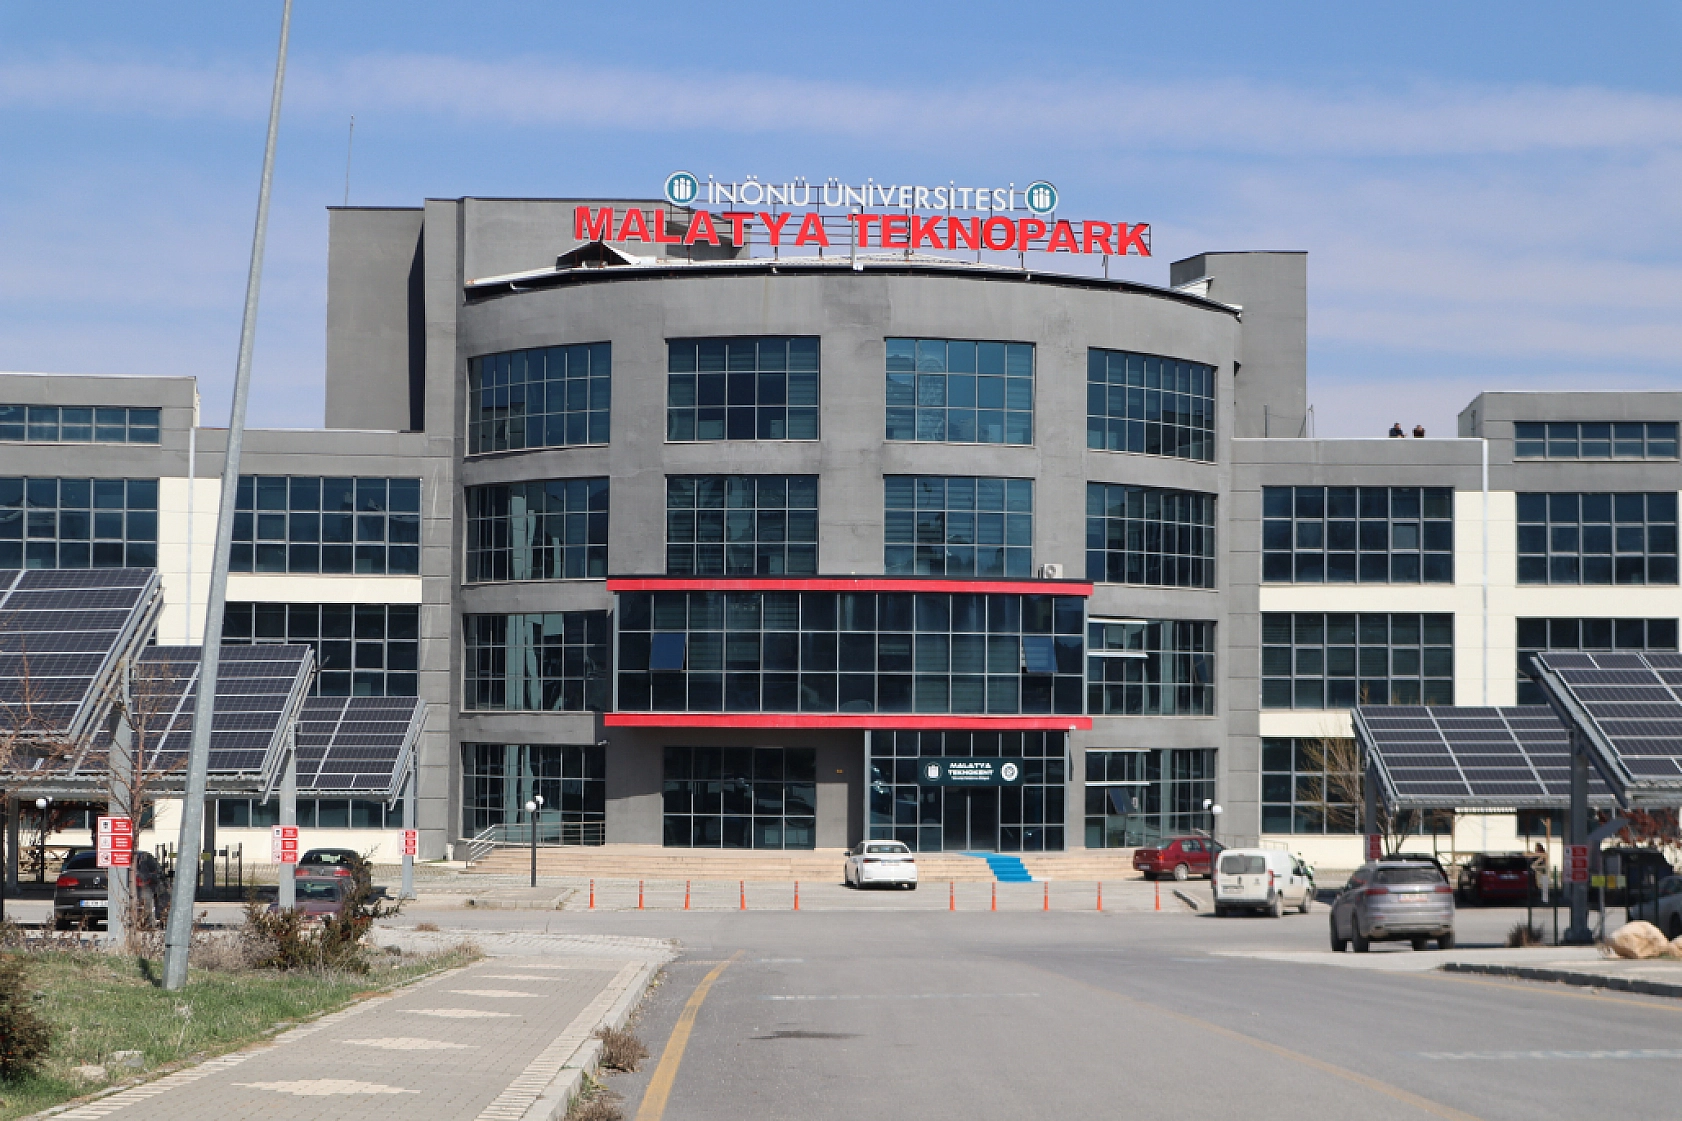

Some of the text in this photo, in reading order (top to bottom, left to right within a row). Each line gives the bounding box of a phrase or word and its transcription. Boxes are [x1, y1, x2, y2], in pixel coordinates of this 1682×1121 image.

[708, 173, 1015, 211] İNÖNÜ ÜNİVERSİTESİ
[574, 206, 1152, 257] MALATYA TEKNOPARK
